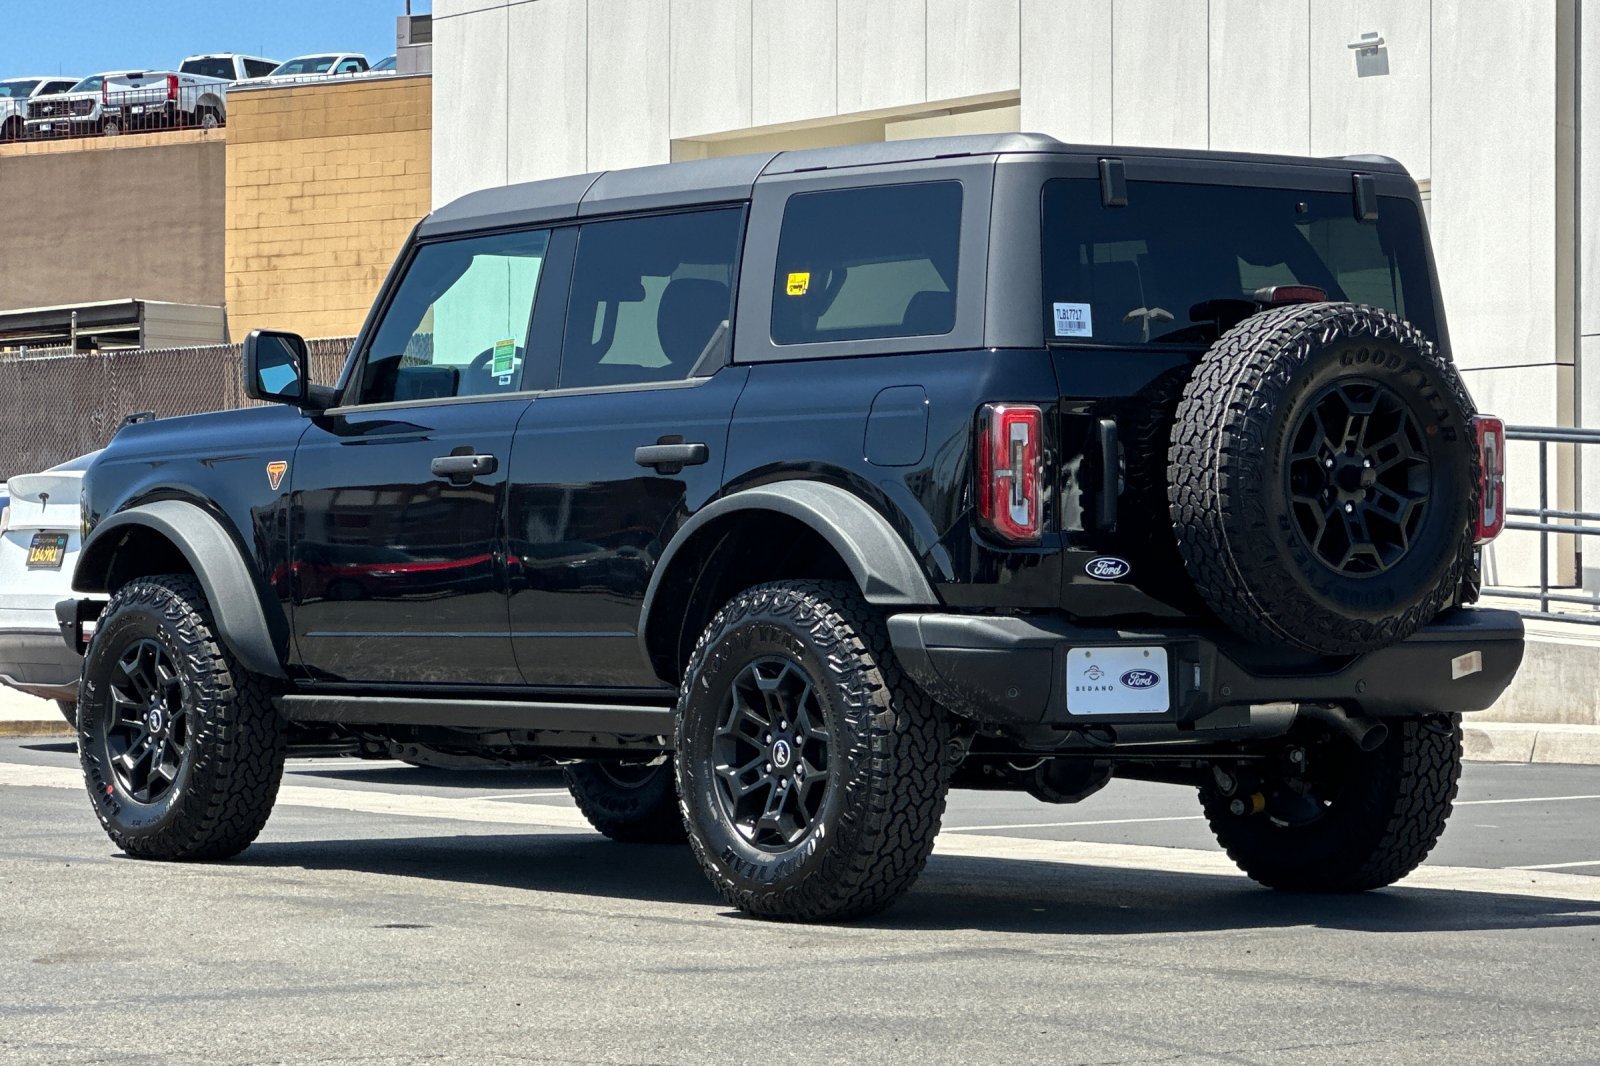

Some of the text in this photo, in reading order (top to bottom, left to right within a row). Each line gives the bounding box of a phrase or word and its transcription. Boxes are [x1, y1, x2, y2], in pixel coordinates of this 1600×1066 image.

[1056, 309, 1083, 320] TLB17717
[1094, 560, 1122, 575] Ford
[1128, 672, 1152, 686] Ford
